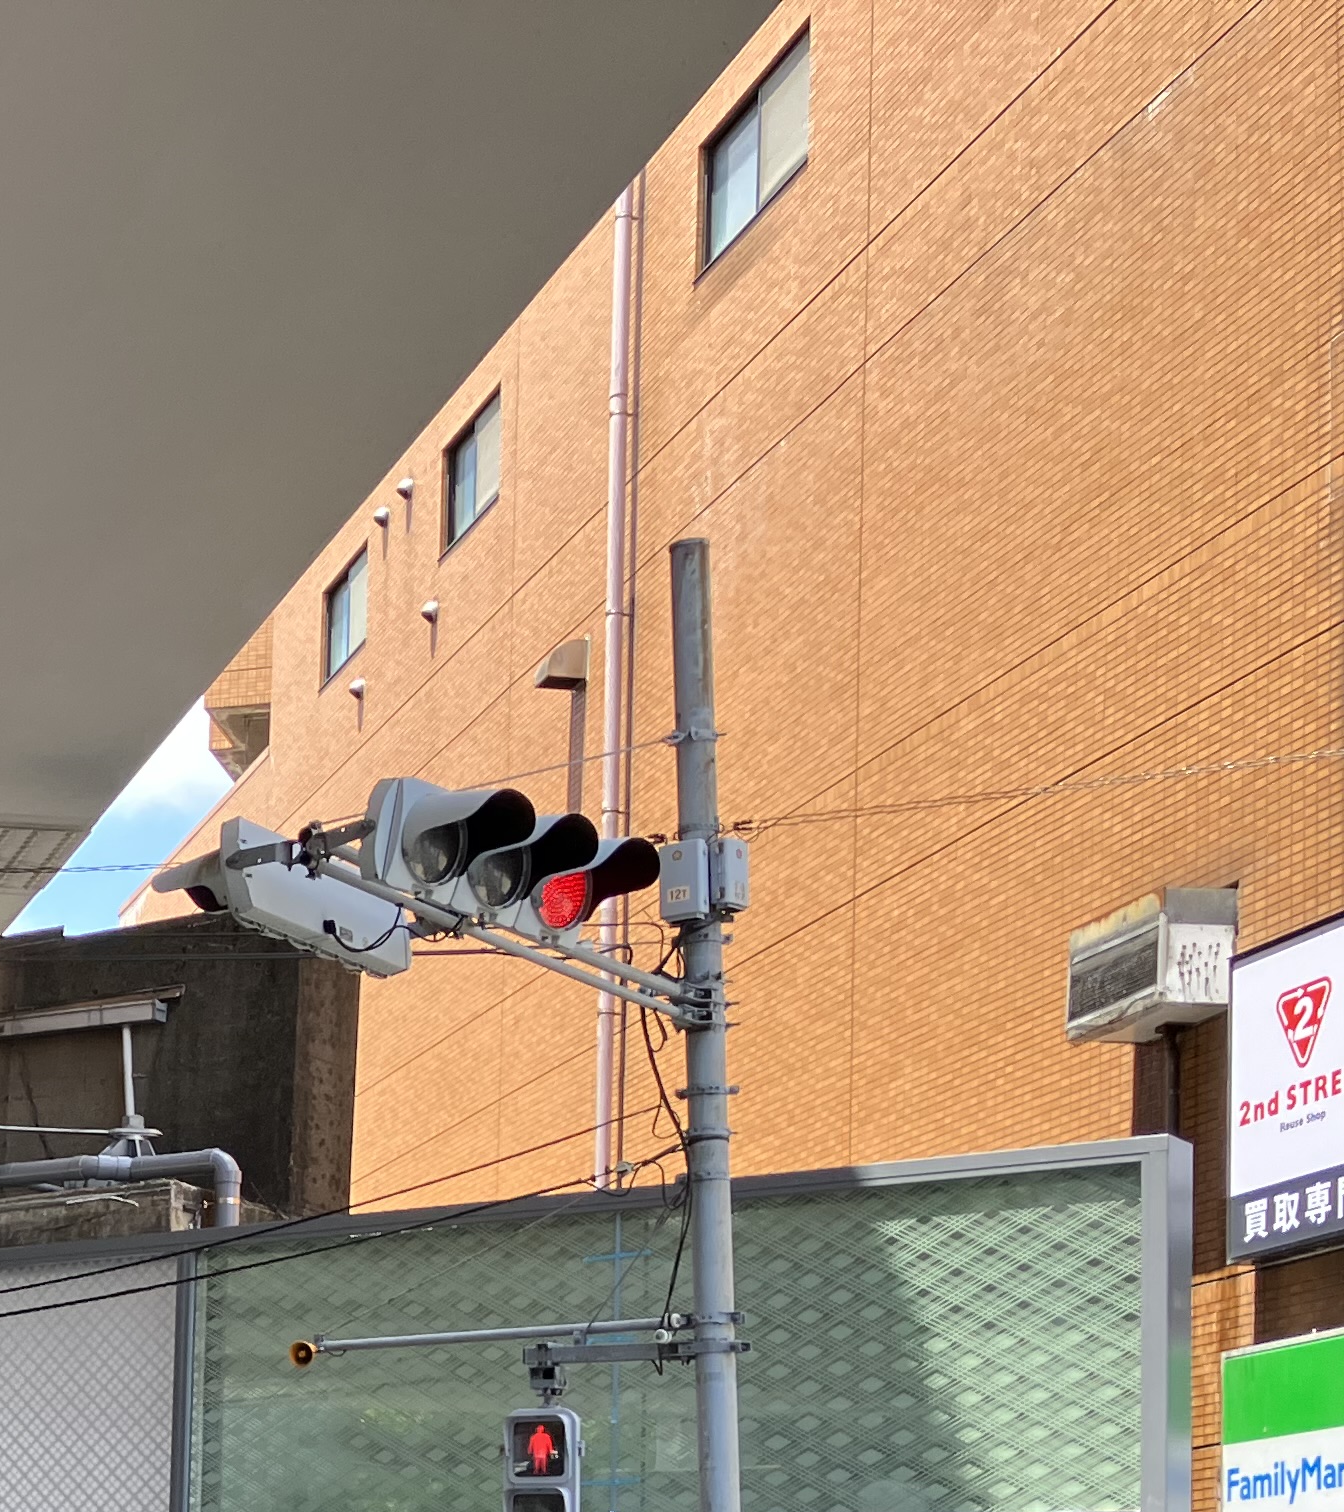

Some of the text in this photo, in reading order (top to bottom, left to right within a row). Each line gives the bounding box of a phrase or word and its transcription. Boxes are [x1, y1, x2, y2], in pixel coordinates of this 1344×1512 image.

[1239, 1068, 1343, 1127] 2nd STRE
[1279, 1109, 1326, 1133] Reuse Shop
[1243, 1175, 1344, 1243] 買取専
